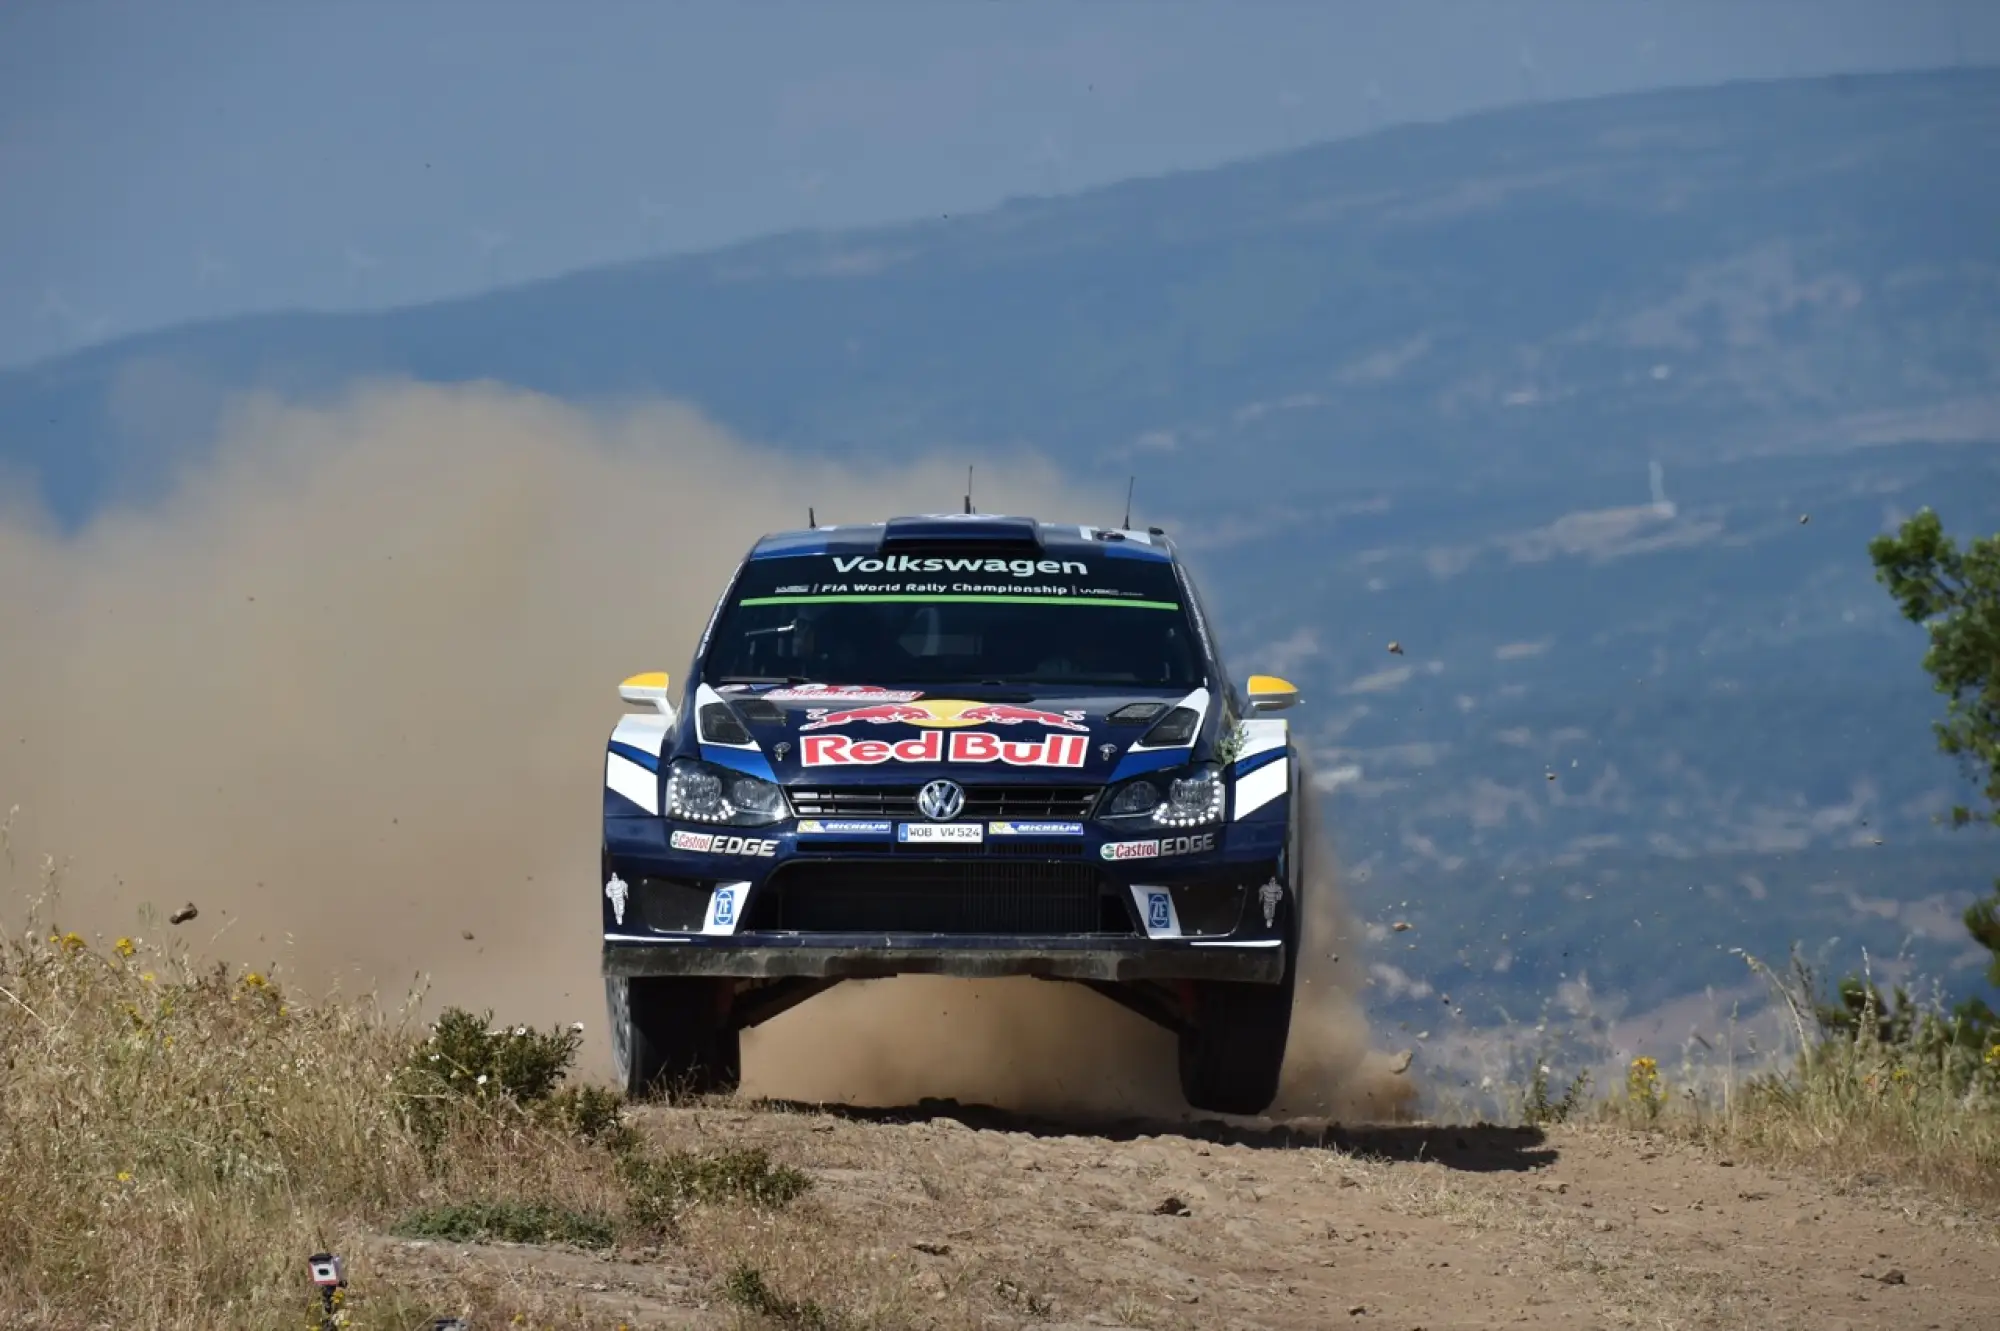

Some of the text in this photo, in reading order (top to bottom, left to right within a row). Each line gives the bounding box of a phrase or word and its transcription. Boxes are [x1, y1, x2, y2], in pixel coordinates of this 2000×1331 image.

[832, 555, 1088, 577] Volkswagen
[821, 583, 848, 593] FIA
[853, 583, 901, 592] World
[905, 583, 947, 593] Rally
[952, 583, 1067, 596] Championship
[800, 730, 1089, 767] Red Bull
[908, 827, 932, 838] WOB
[1017, 823, 1080, 833] MICHELIN
[711, 835, 780, 857] EDGE
[1115, 833, 1216, 858] Castrol EDGE
